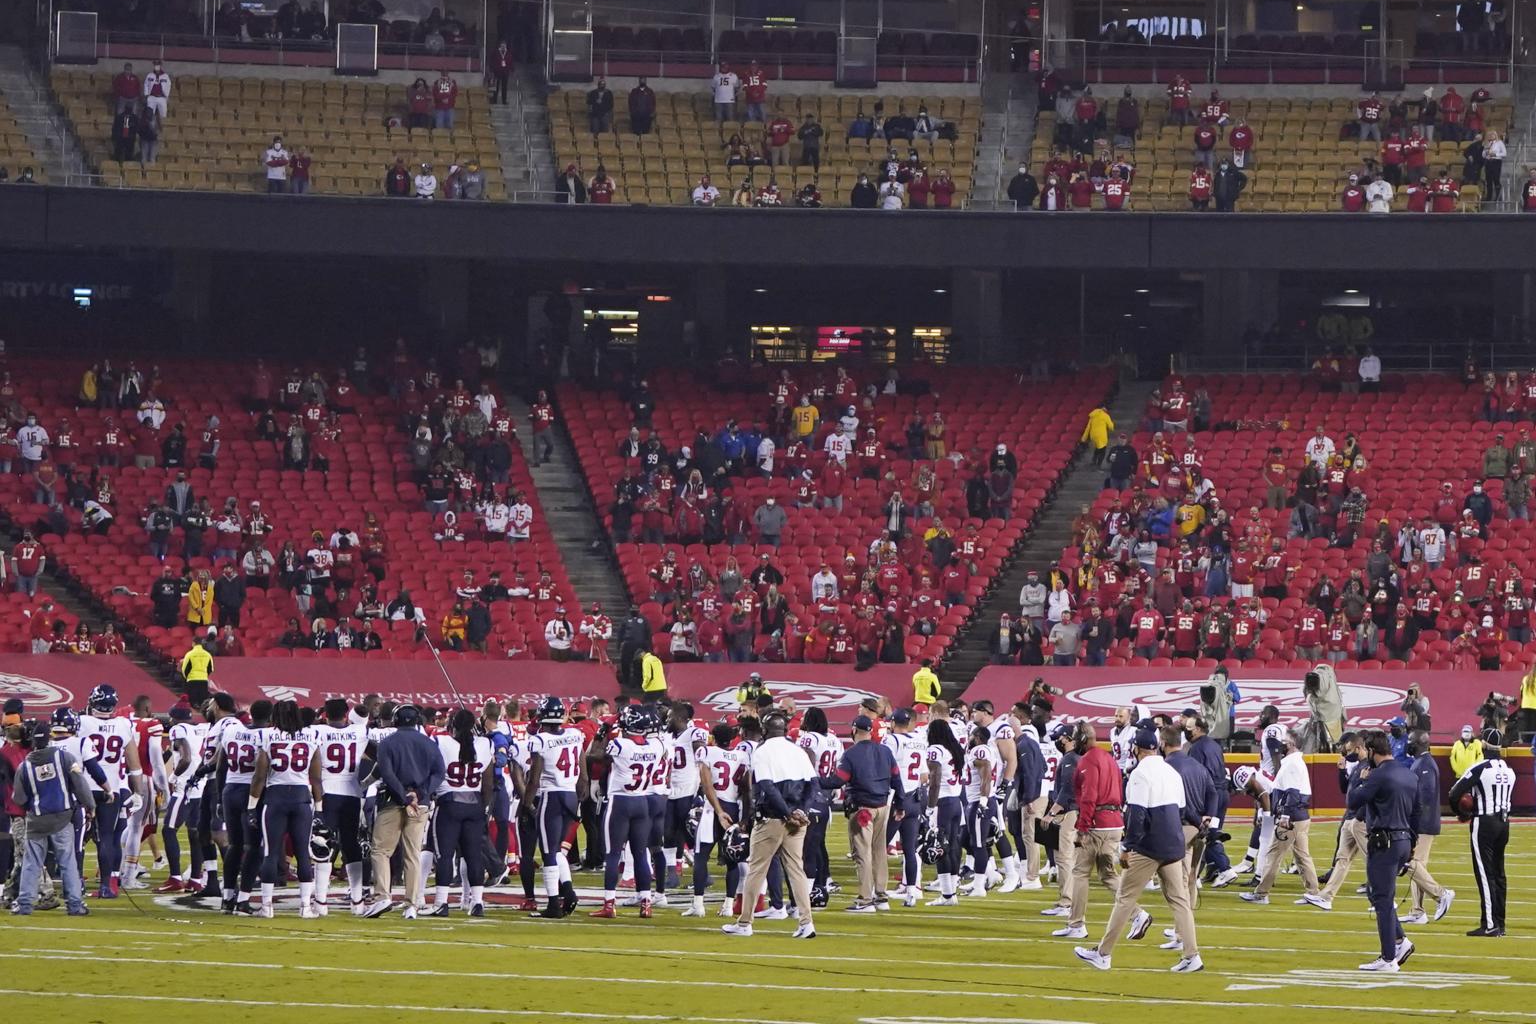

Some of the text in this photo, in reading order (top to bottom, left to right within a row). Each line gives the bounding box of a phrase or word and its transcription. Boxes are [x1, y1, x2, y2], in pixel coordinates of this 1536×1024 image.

[1207, 106, 1220, 116] 58
[1107, 184, 1122, 195] 25
[308, 409, 320, 419] 42
[497, 421, 508, 431] 32
[106, 434, 116, 444] 15
[1184, 454, 1195, 464] 81
[1331, 471, 1344, 482] 32
[964, 542, 974, 553] 15
[22, 548, 34, 559] 17
[1467, 567, 1481, 579] 15
[1141, 617, 1153, 628] 29
[1179, 618, 1192, 628] 55
[1236, 624, 1248, 634] 15
[79, 641, 90, 651] 53
[836, 642, 845, 651] 10
[326, 732, 357, 741] WATKINS
[227, 741, 256, 773] 92
[270, 742, 310, 772] 58
[326, 743, 357, 773] 91
[556, 746, 579, 778] 41
[630, 752, 656, 761] JOHNSON
[908, 752, 921, 780] 2
[446, 761, 483, 788] 96
[624, 763, 654, 791] 31
